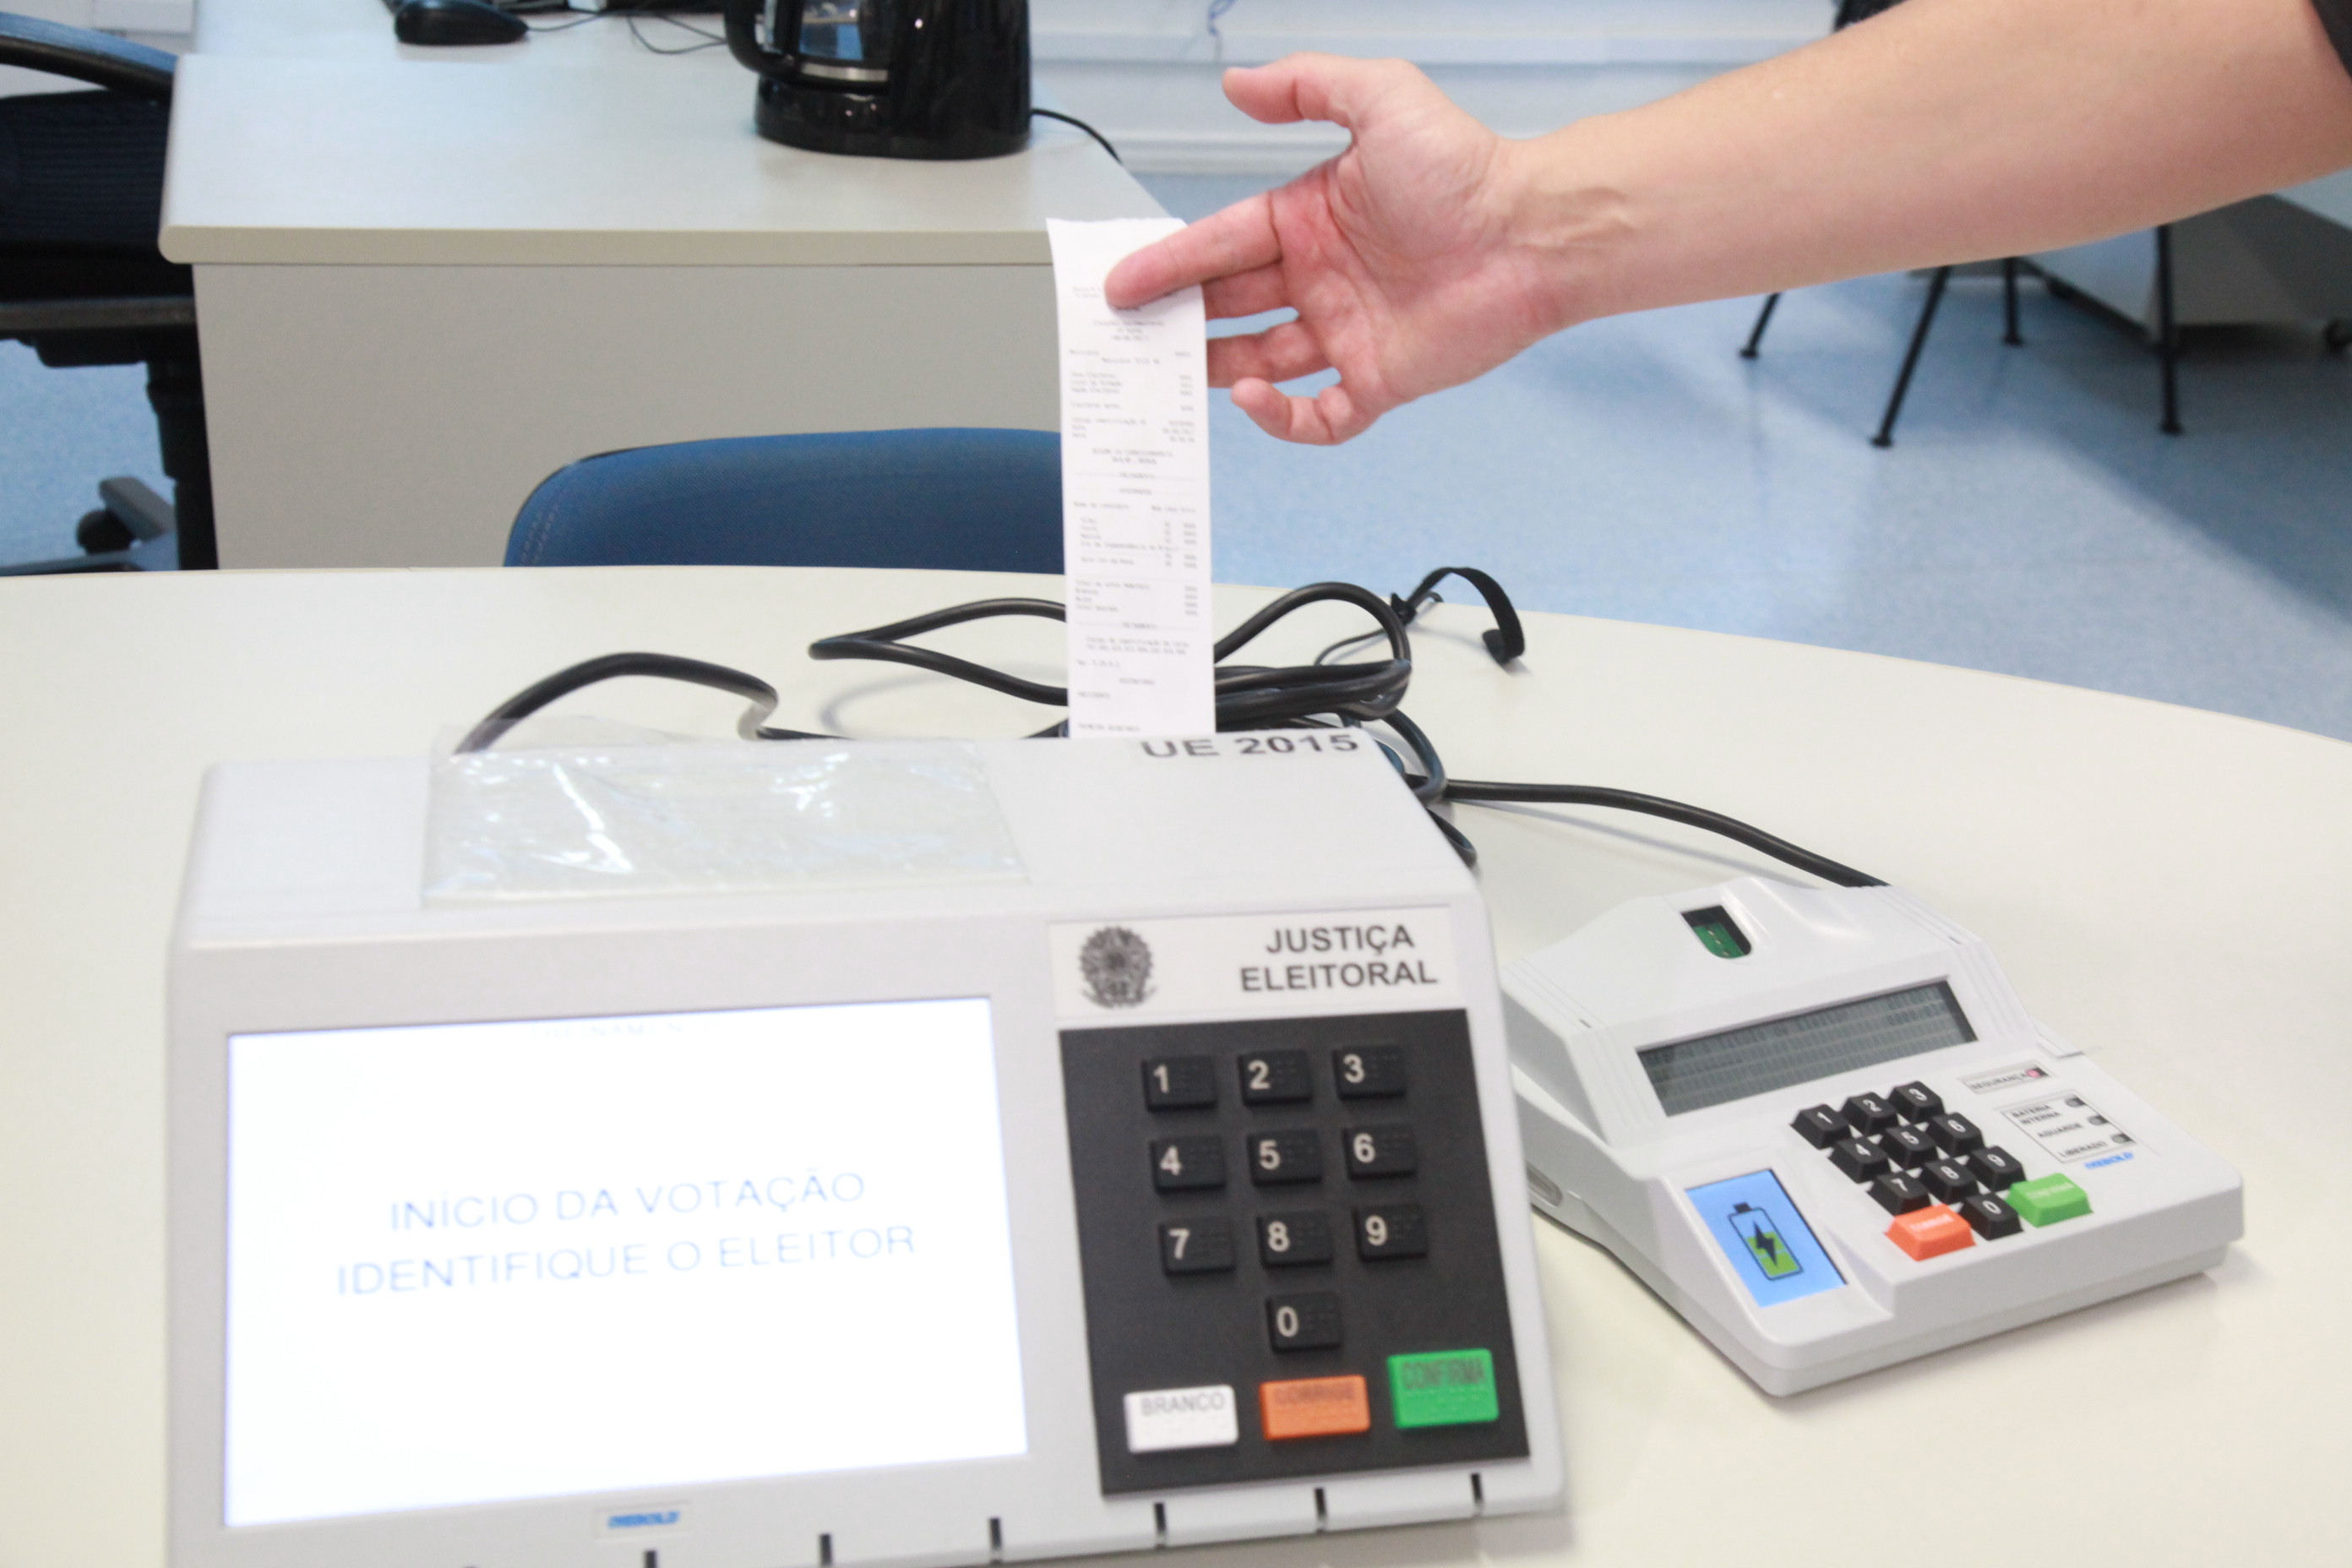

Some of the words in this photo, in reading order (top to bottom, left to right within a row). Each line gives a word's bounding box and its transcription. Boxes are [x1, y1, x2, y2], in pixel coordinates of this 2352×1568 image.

[1142, 738, 1219, 758] UE
[1234, 734, 1358, 754] 2015
[1266, 925, 1414, 956] JUSTIÇA
[1240, 960, 1438, 992] ELEITORAL
[1154, 1064, 1169, 1093] 1
[1248, 1060, 1271, 1090] 2
[1343, 1054, 1365, 1084] 3
[1817, 1111, 1832, 1125] 1
[1862, 1099, 1881, 1113] 2
[1908, 1087, 1928, 1102] 3
[1902, 1130, 1920, 1146] 5
[1947, 1119, 1966, 1134] 6
[1160, 1146, 1182, 1175] 4
[1259, 1140, 1282, 1169] 5
[1353, 1133, 1376, 1162] 6
[1941, 1165, 1959, 1180] 8
[1987, 1153, 2006, 1168] 9
[391, 1190, 538, 1231] INÍCIO
[556, 1189, 618, 1222] DA
[635, 1167, 865, 1213] VOTAÇÃO
[1168, 1228, 1190, 1260] 7
[1267, 1221, 1291, 1252] 8
[1365, 1215, 1388, 1246] 9
[337, 1244, 649, 1295] IDENTIFIQUE
[667, 1241, 701, 1271] O
[719, 1225, 915, 1268] ELEITOR
[1276, 1306, 1299, 1337] 0
[1141, 1391, 1226, 1417] BRANCO
